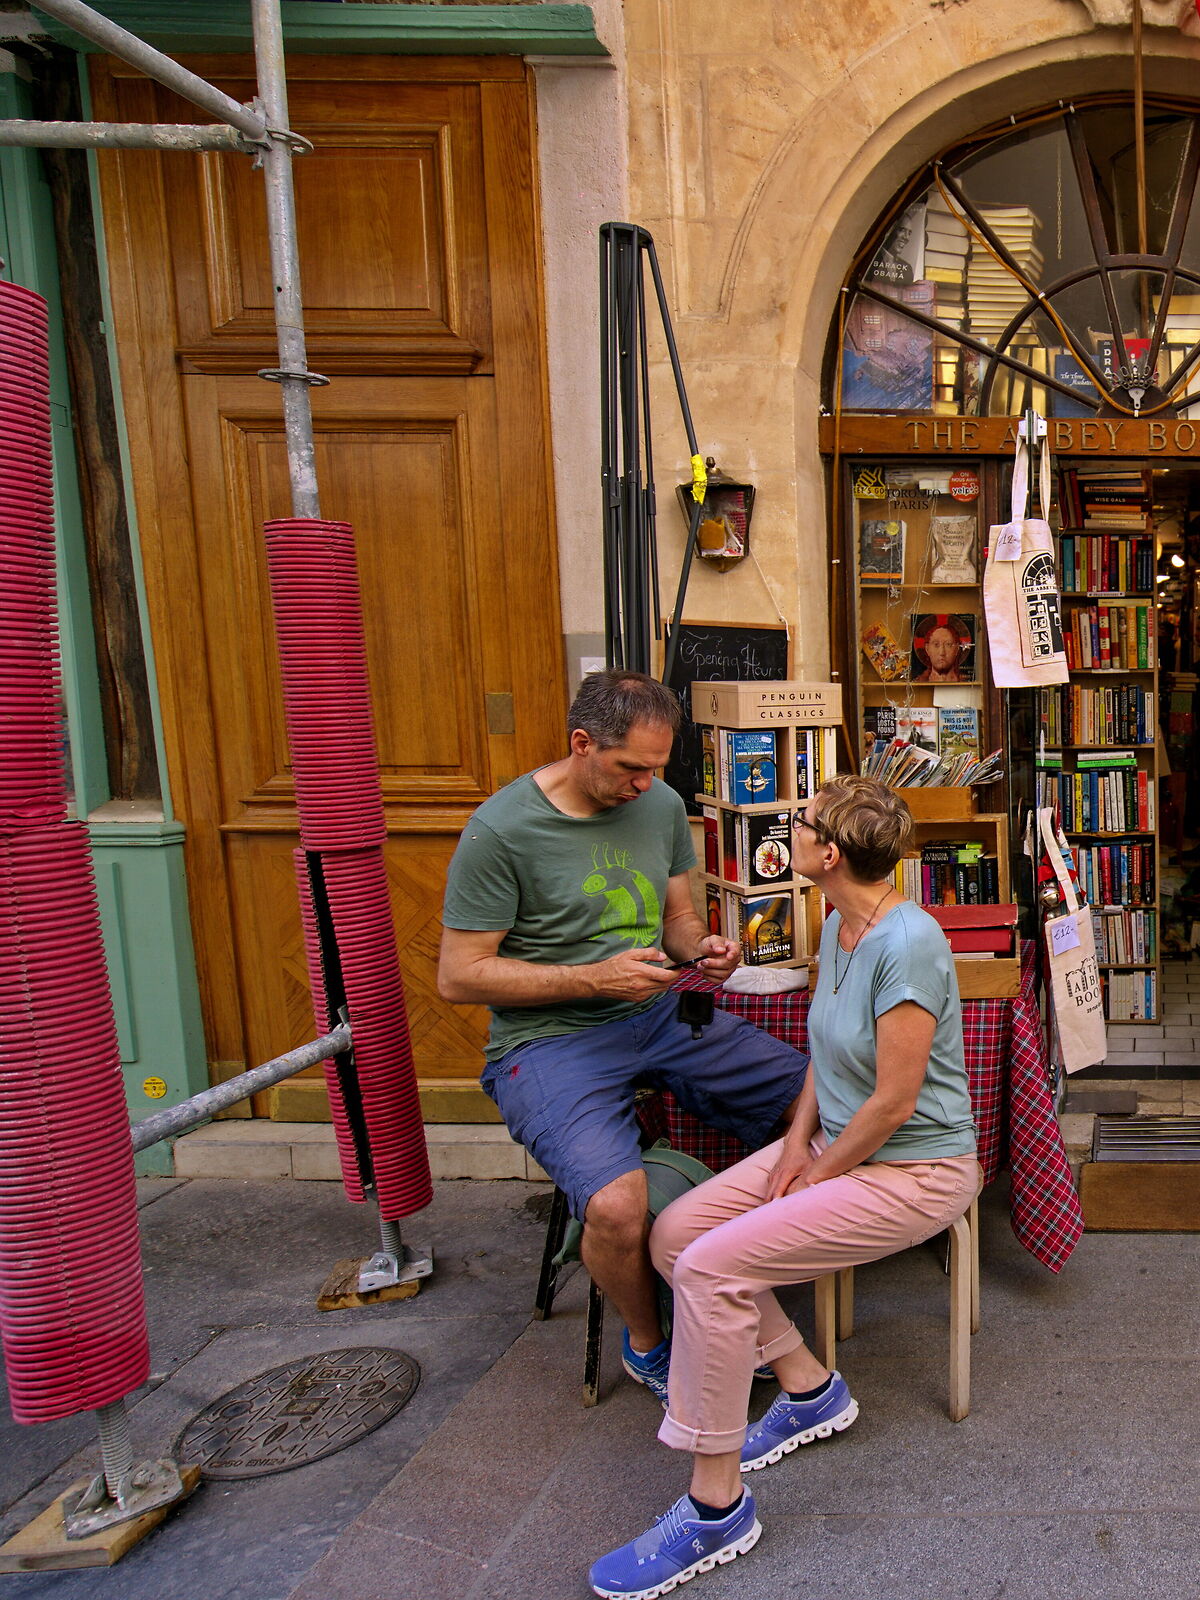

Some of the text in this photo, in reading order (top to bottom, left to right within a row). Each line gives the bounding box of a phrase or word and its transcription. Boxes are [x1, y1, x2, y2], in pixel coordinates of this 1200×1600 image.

[873, 260, 908, 272] BARACK
[873, 269, 905, 280] OBAMA
[905, 420, 980, 450] THE
[1000, 420, 1124, 451] ABEY
[854, 486, 884, 495] LET'S GO
[885, 488, 941, 498] TORONTO
[952, 487, 971, 496] yelp
[893, 500, 929, 510] PARIS
[680, 638, 784, 681] Opening Hours
[761, 692, 822, 701] PENGUIN
[760, 709, 824, 719] CLASSICS
[877, 711, 895, 720] PARIS
[877, 726, 895, 734] FOUND
[1054, 925, 1075, 941] €12-
[752, 943, 790, 957] HAMILTON
[319, 1368, 356, 1379] GAZ
